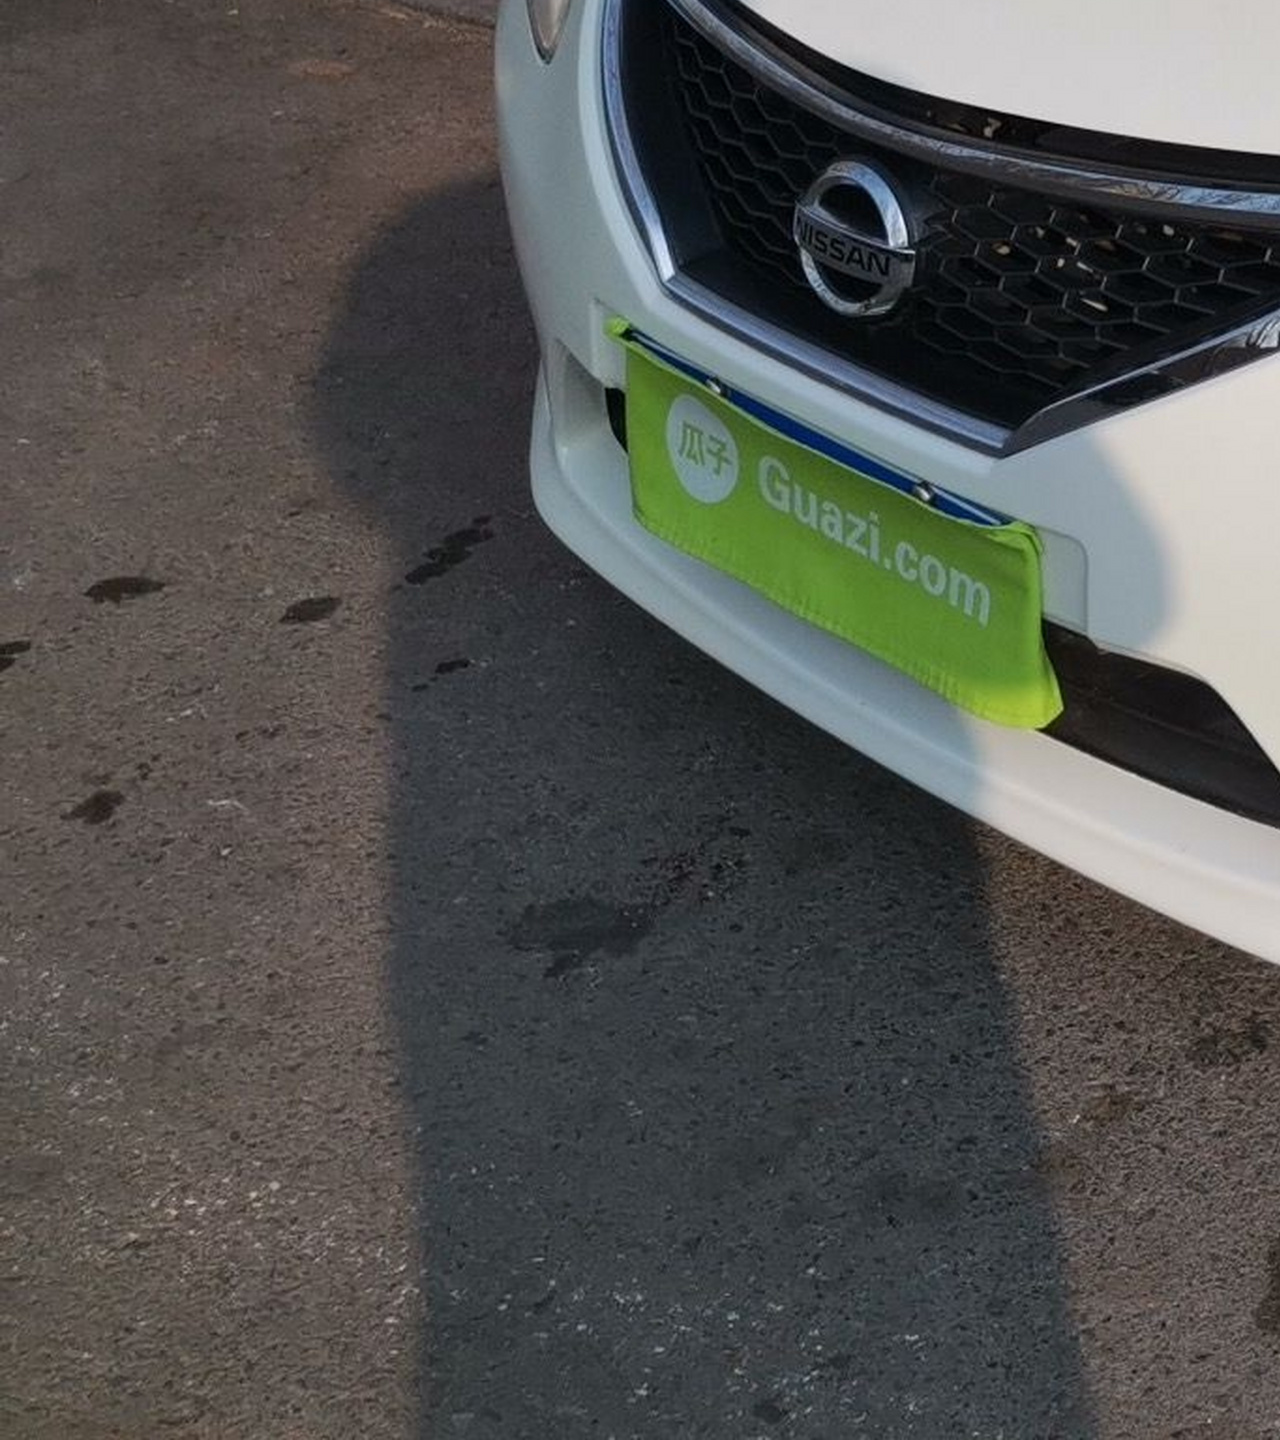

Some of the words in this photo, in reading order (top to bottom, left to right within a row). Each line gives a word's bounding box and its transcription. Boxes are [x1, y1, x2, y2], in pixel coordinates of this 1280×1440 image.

[799, 217, 890, 277] NISSAN
[677, 421, 735, 477] 瓜子
[757, 454, 991, 630] Guazi.com
